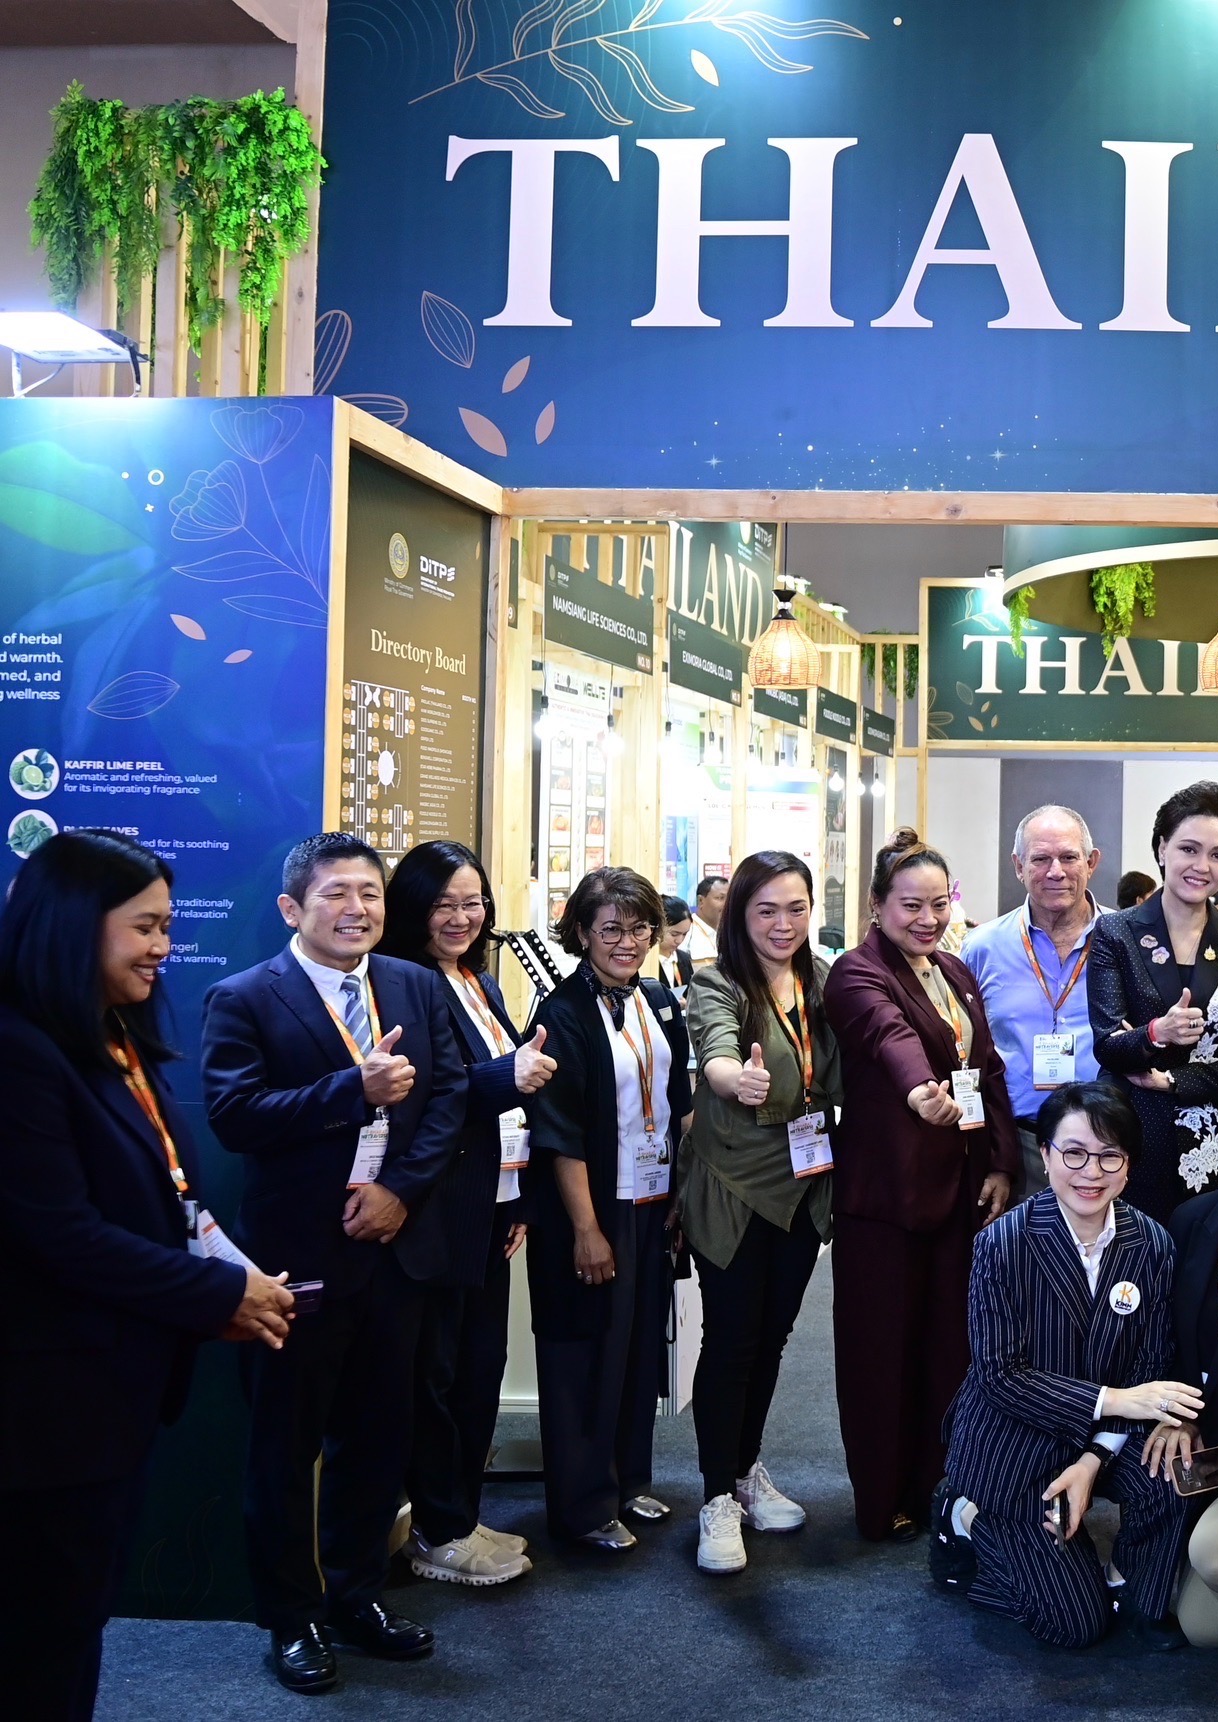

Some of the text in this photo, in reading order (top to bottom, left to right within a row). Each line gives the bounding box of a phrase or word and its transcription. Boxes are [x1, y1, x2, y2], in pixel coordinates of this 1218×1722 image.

[420, 555, 447, 579] DITP
[552, 594, 587, 622] NAMSIANG
[586, 609, 600, 627] LIFE
[599, 615, 627, 638] SCIENCES
[637, 630, 648, 647] LTD.
[3, 633, 62, 645] of herbal
[9, 652, 64, 663] warmth.
[371, 628, 466, 676] Directory Board
[34, 670, 61, 681] and
[6, 688, 60, 700] wellness
[64, 760, 165, 771] KAFFIR LIME PEEL
[63, 772, 218, 784] Aromatic and refreshing, valued
[63, 784, 201, 795] for its invigorating fragrance
[157, 839, 172, 848] for
[172, 840, 186, 849] its
[186, 840, 230, 851] soothing
[176, 898, 235, 910] traditionally
[180, 909, 228, 919] relaxation
[170, 955, 227, 966] its warming
